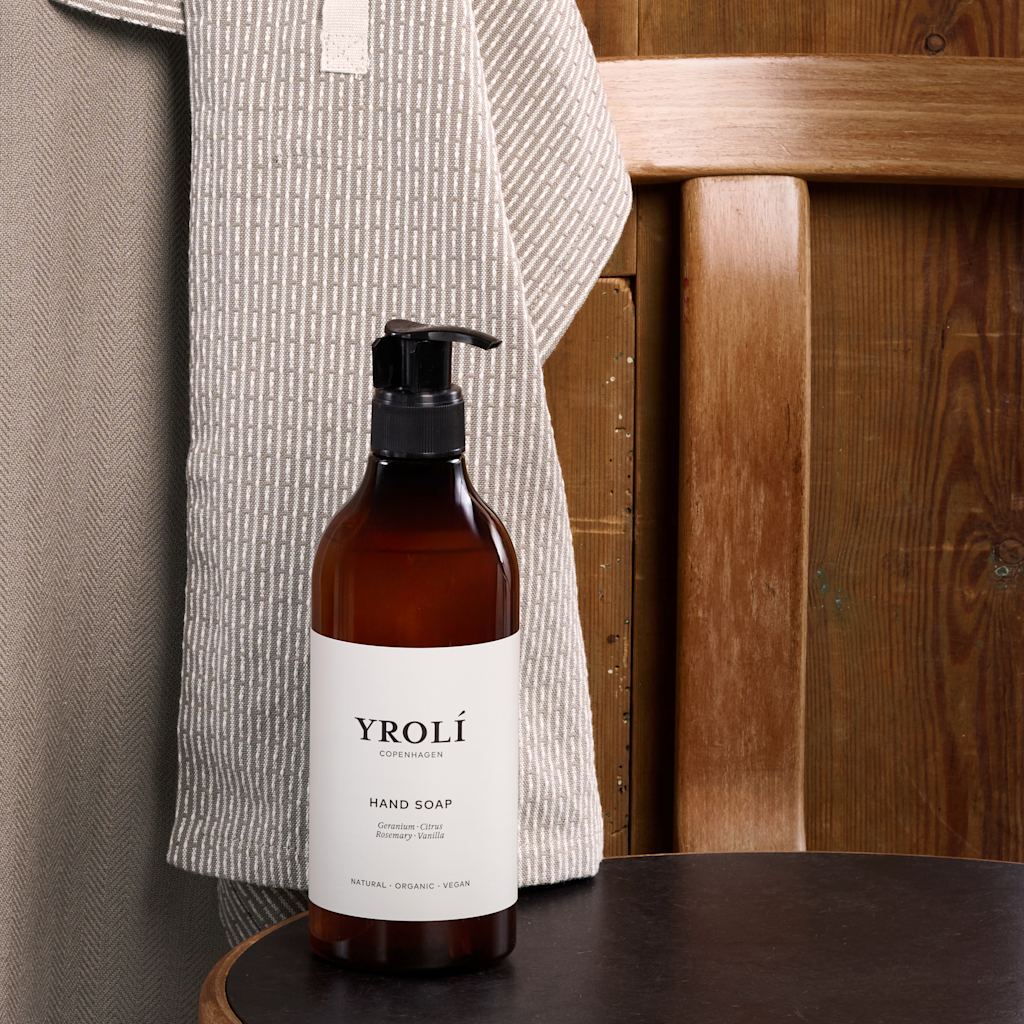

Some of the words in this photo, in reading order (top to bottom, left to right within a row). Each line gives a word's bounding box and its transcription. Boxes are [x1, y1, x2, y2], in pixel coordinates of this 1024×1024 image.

[354, 709, 466, 744] YROLÍ
[379, 750, 443, 759] COPENHAGEN
[369, 797, 410, 810] HAND
[415, 798, 453, 810] SOAP
[377, 821, 415, 831] Geranium
[419, 822, 443, 831] Citrus
[375, 830, 413, 841] Rosemary
[417, 831, 445, 840] Vanilla
[350, 878, 387, 889] NATURAL
[394, 882, 435, 890] ORGANIC
[443, 880, 471, 889] VEGAN
